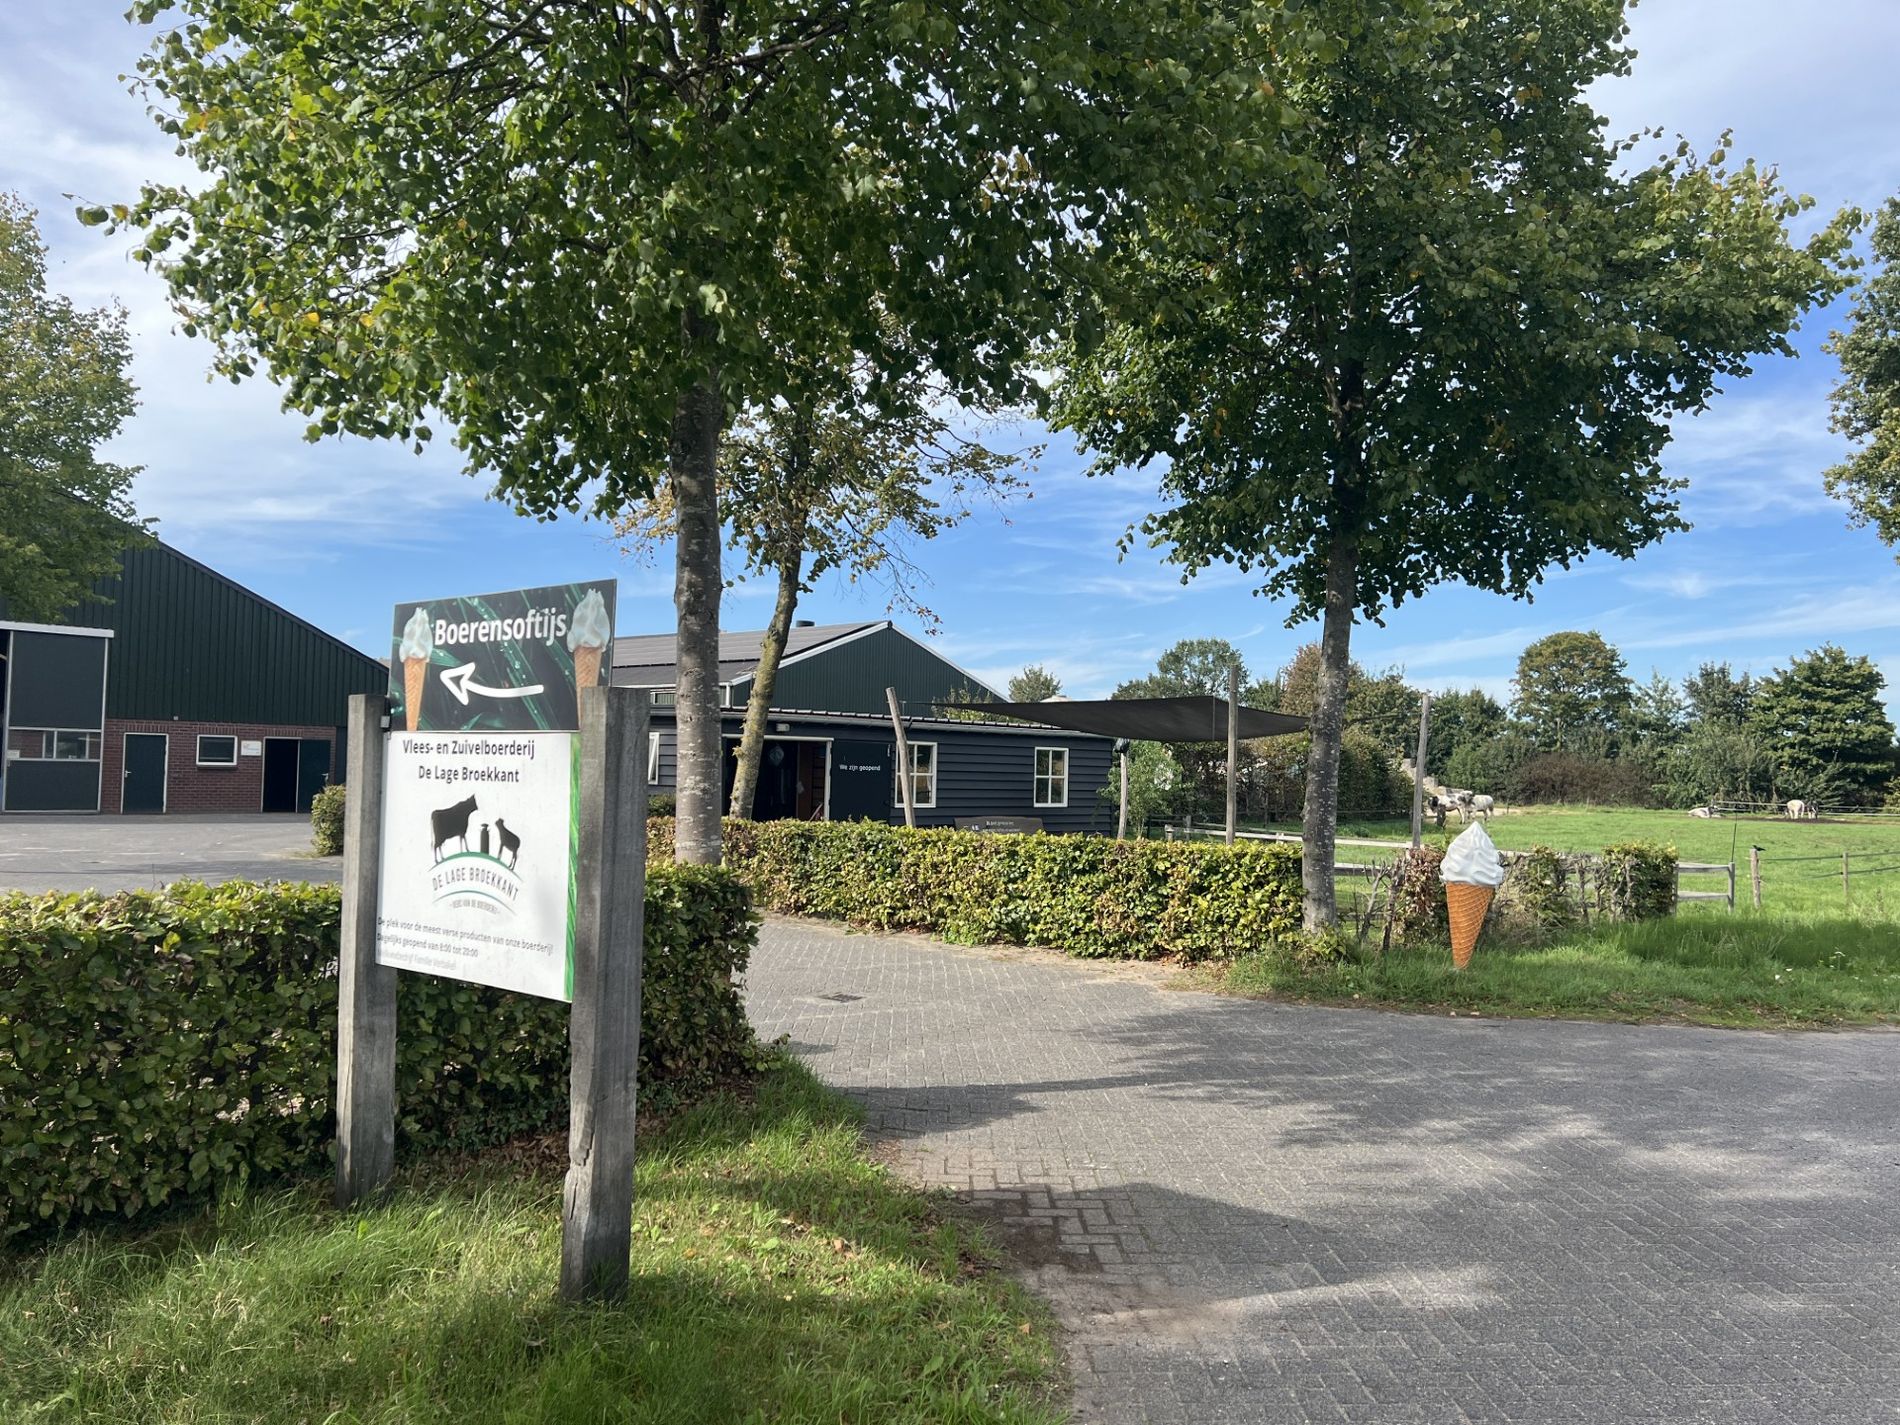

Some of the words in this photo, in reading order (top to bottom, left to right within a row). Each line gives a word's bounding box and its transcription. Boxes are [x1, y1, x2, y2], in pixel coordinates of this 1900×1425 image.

[434, 607, 567, 646] Boerensoftijs
[403, 739, 433, 754] Vlees-
[436, 743, 449, 755] en
[452, 740, 535, 760] Zuivelboerderij
[418, 765, 432, 780] De
[434, 766, 459, 784] Lage
[462, 766, 520, 783] Broekkant
[432, 874, 443, 891] DE
[445, 867, 466, 885] LAGE
[469, 867, 519, 901] BROEKKANT
[400, 922, 414, 932] voor
